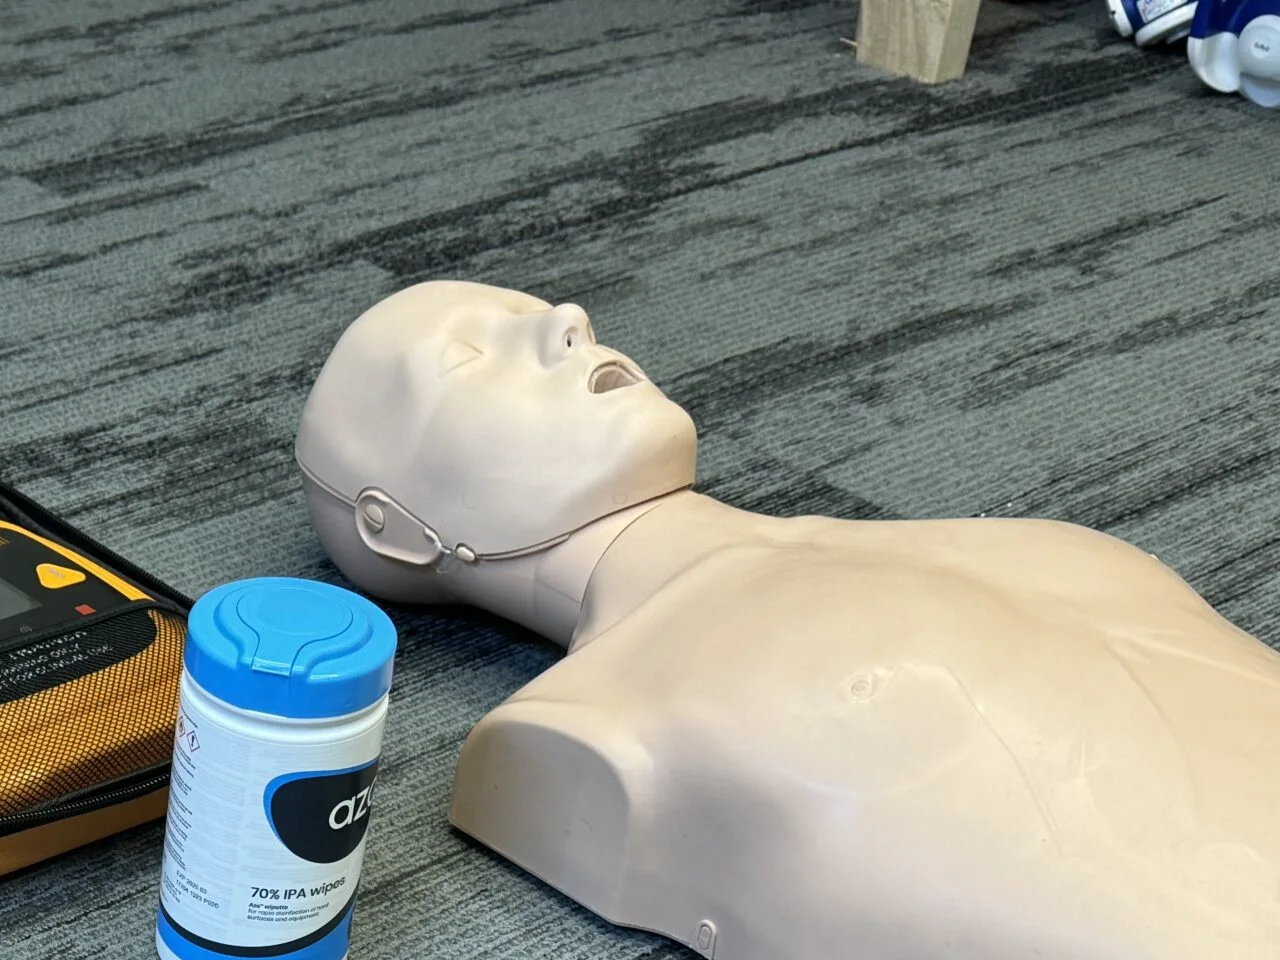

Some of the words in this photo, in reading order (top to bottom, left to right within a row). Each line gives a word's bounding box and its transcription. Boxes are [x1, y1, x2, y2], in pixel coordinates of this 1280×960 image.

[250, 886, 280, 900] 70%
[283, 888, 307, 900] IPA
[310, 877, 346, 896] wipes
